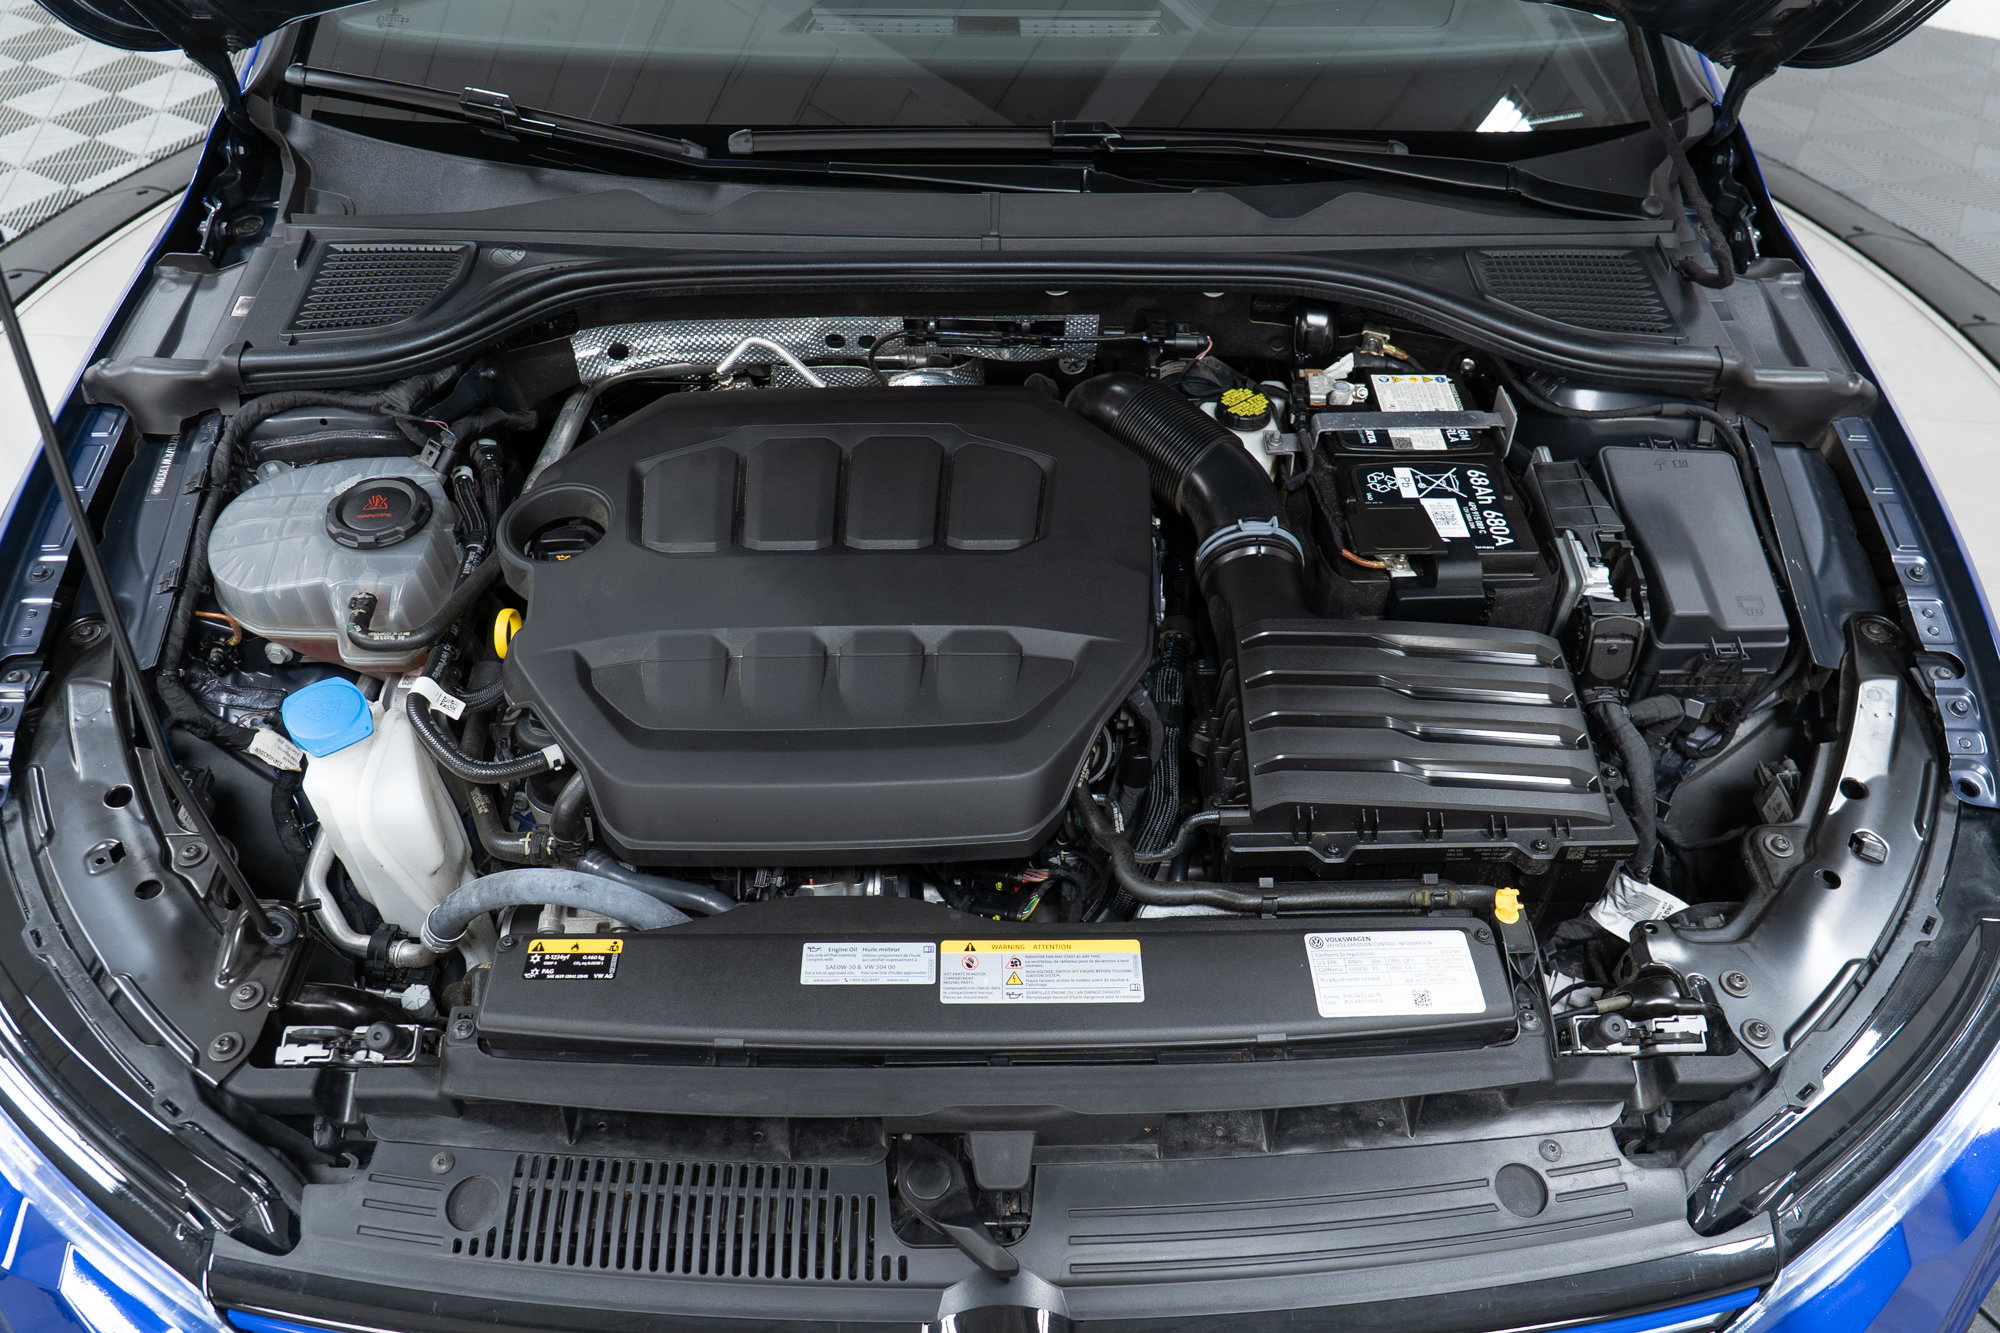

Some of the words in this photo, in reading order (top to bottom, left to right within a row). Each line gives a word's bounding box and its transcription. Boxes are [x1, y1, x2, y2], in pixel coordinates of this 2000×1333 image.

[1366, 430, 1377, 444] RTA
[1446, 428, 1460, 442] RLA
[1457, 429, 1471, 440] GM
[1400, 477, 1410, 488] Pb
[1466, 469, 1496, 504] 68Ah
[1482, 510, 1514, 546] 680A
